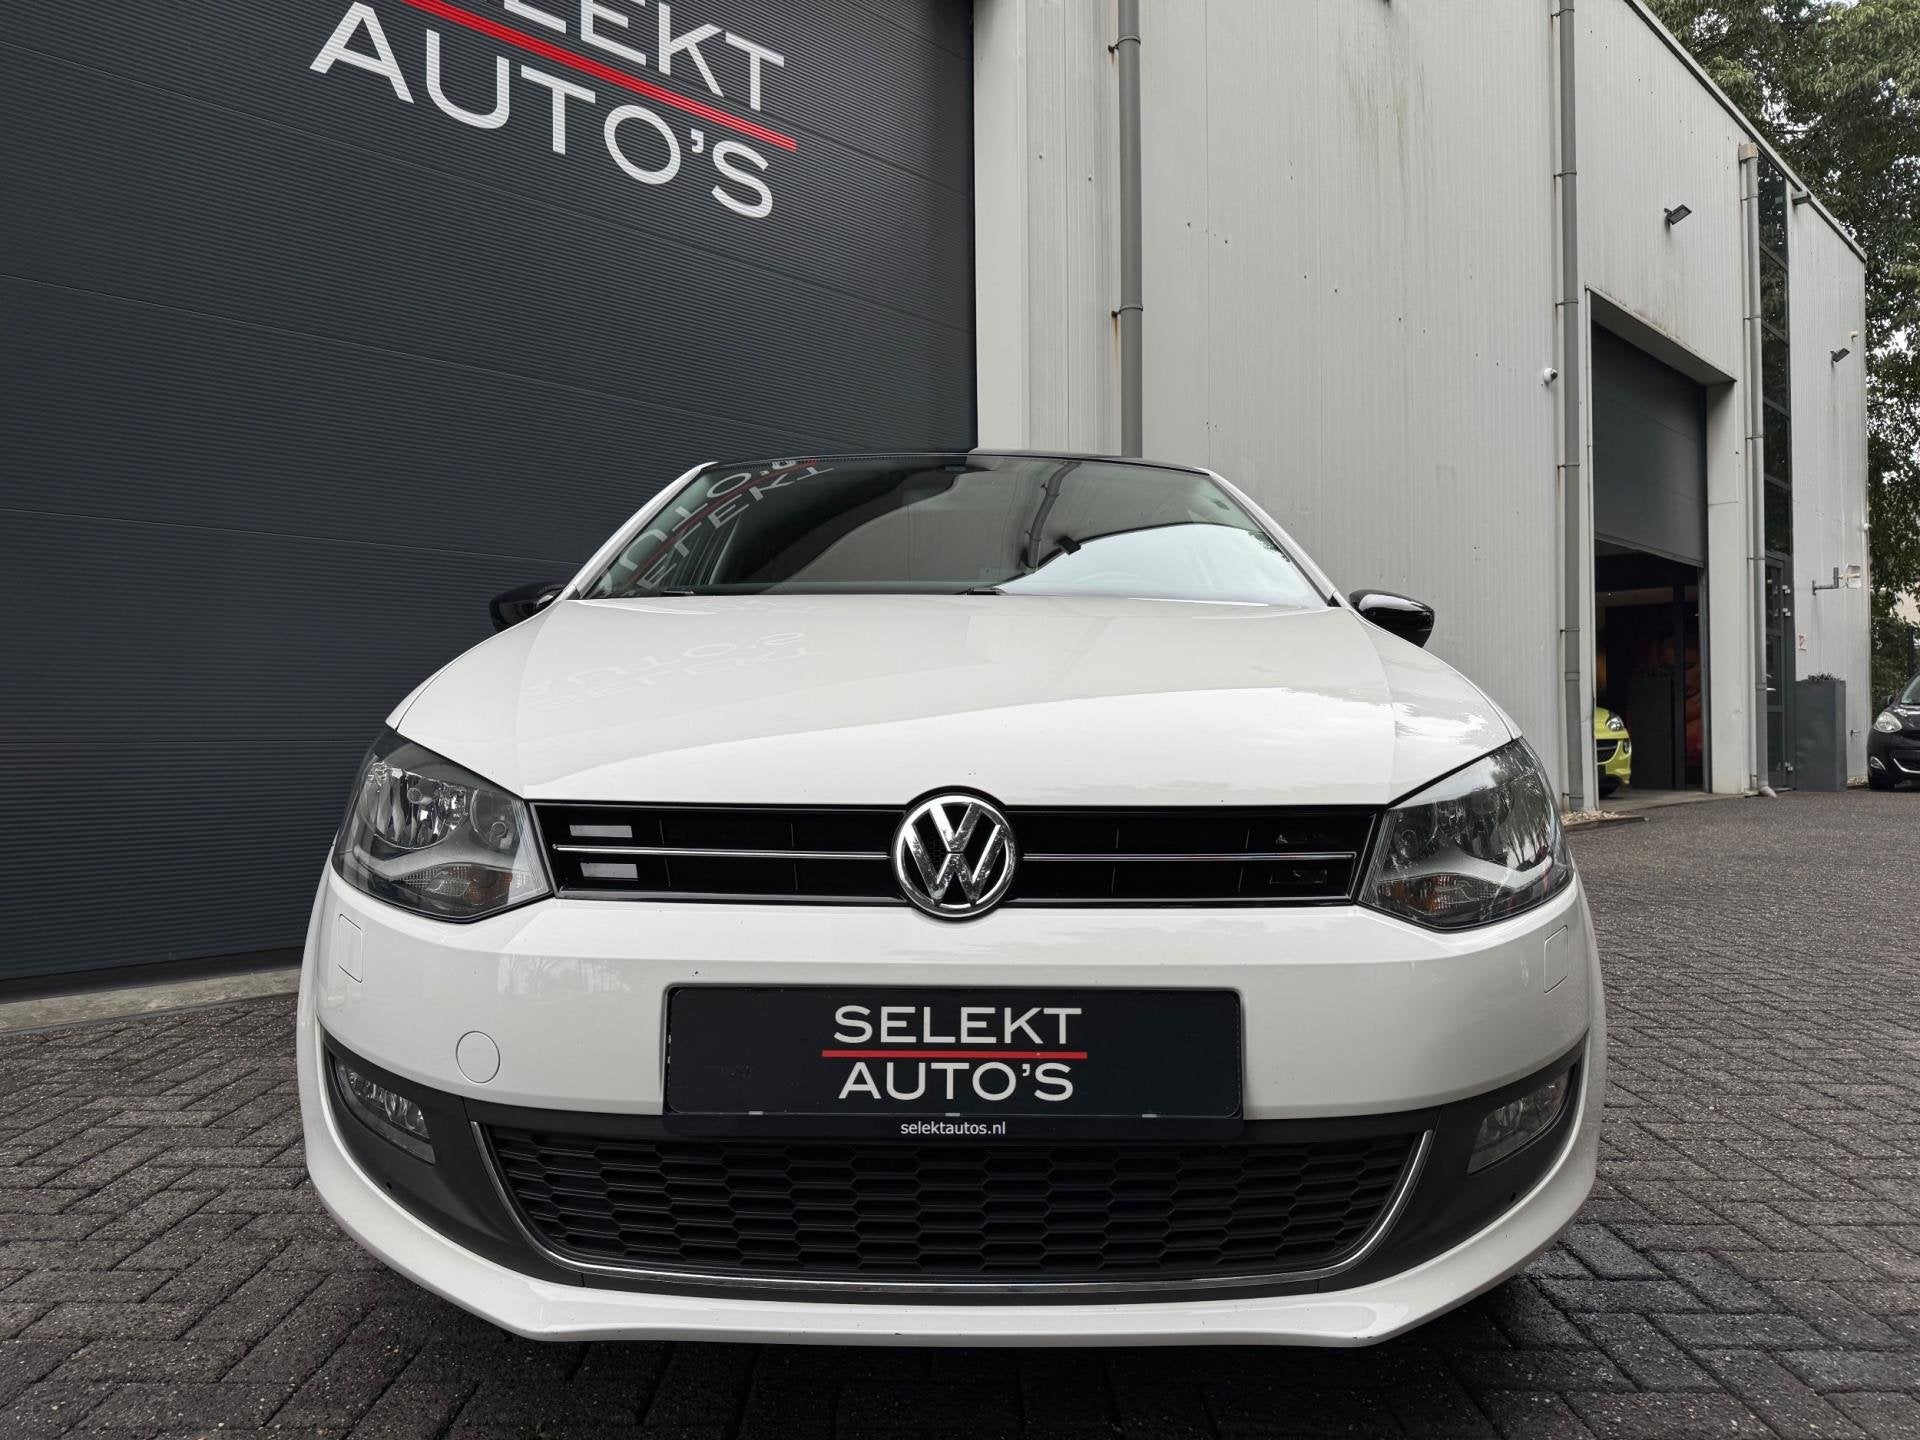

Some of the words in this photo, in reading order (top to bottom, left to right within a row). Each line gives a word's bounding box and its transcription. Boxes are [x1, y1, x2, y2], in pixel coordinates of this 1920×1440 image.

[503, 0, 784, 112] EKT
[309, 1, 773, 219] AUTO'S
[833, 1004, 1082, 1045] SELEKT
[838, 1061, 1074, 1102] AUTO'S
[900, 1120, 1006, 1135] selektautos.nl
